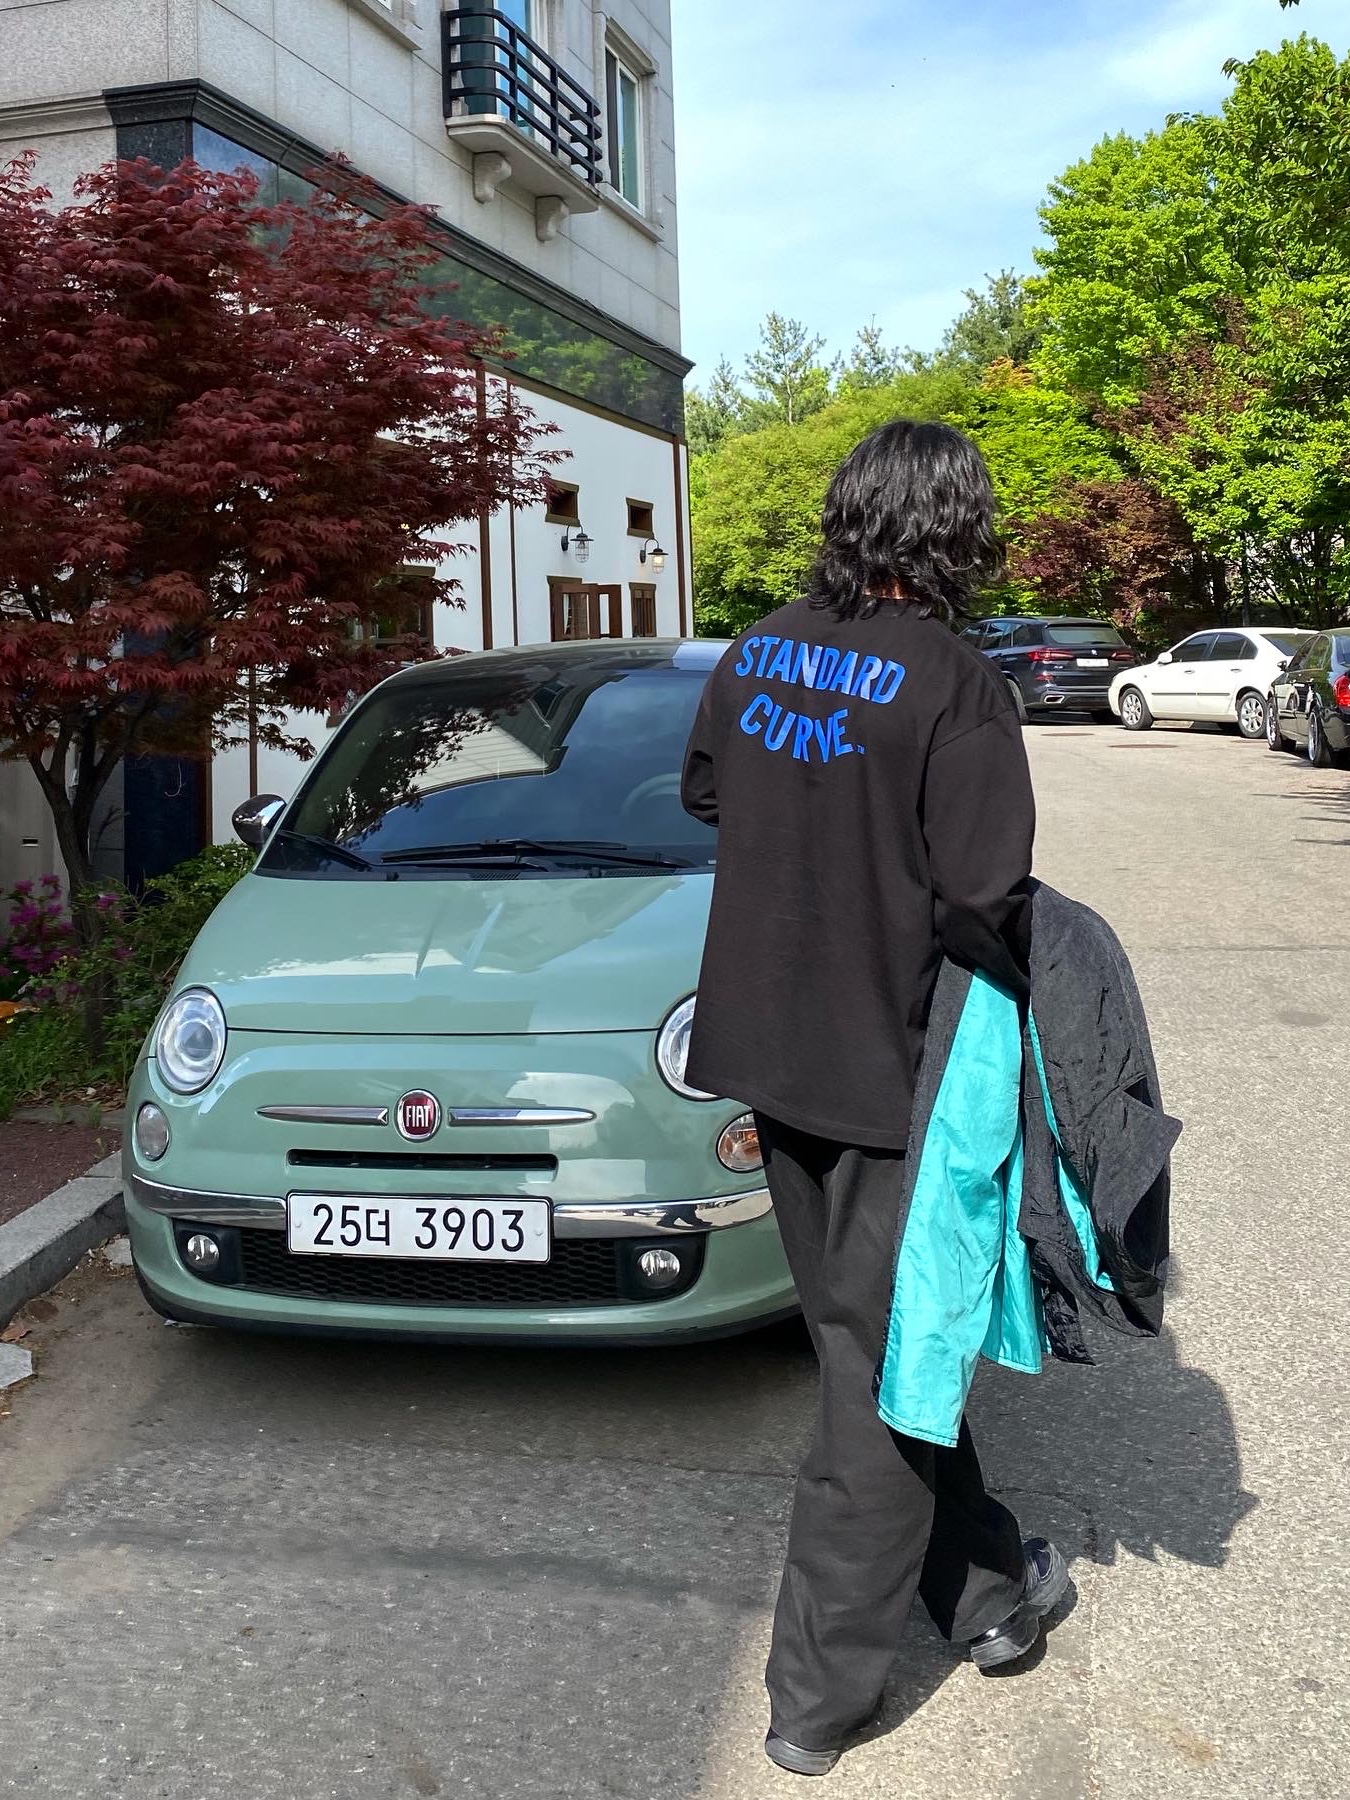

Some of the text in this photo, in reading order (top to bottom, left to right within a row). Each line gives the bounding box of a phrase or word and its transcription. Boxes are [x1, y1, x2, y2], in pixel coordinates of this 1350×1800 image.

[734, 635, 906, 704] STANDARD
[405, 1104, 432, 1128] FIAT
[313, 1203, 525, 1251] 25더 3903
